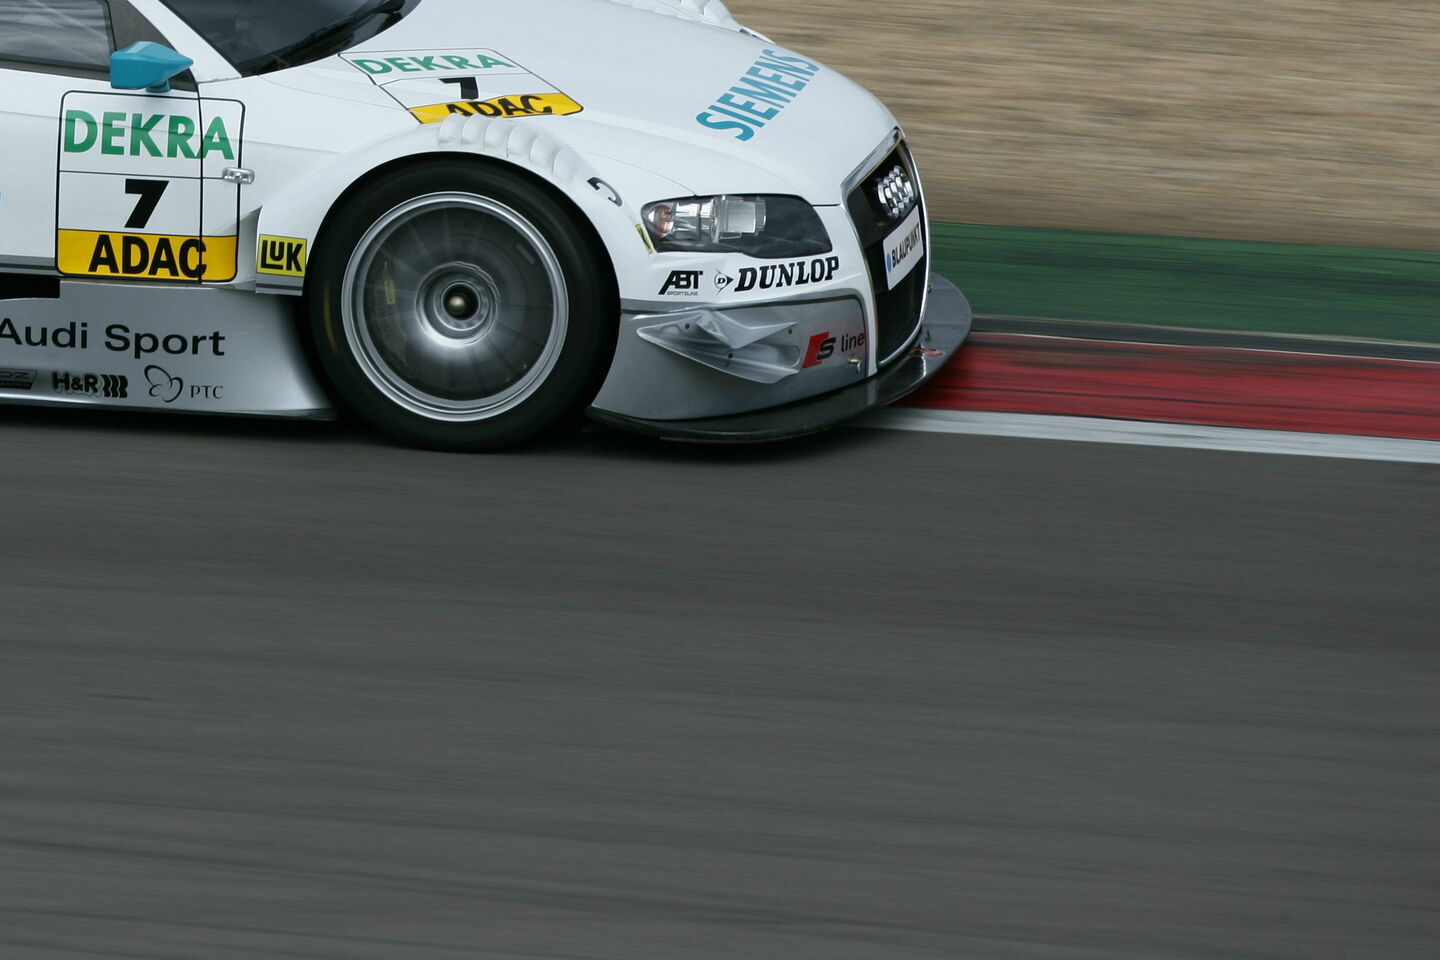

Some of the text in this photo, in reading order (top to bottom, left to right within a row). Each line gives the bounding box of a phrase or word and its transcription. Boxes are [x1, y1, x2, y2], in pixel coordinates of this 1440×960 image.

[351, 54, 517, 74] DEKRA
[446, 95, 553, 118] ADAC
[696, 49, 820, 141] SIEMENS
[64, 109, 235, 160] DEKRA
[124, 178, 169, 228] 7
[88, 234, 208, 278] ADAC
[658, 271, 703, 295] ABT
[734, 256, 840, 292] DUNLOP
[104, 324, 225, 359] Sport
[816, 332, 865, 360] S line
[51, 371, 100, 394] H&R
[190, 385, 224, 399] PTC
